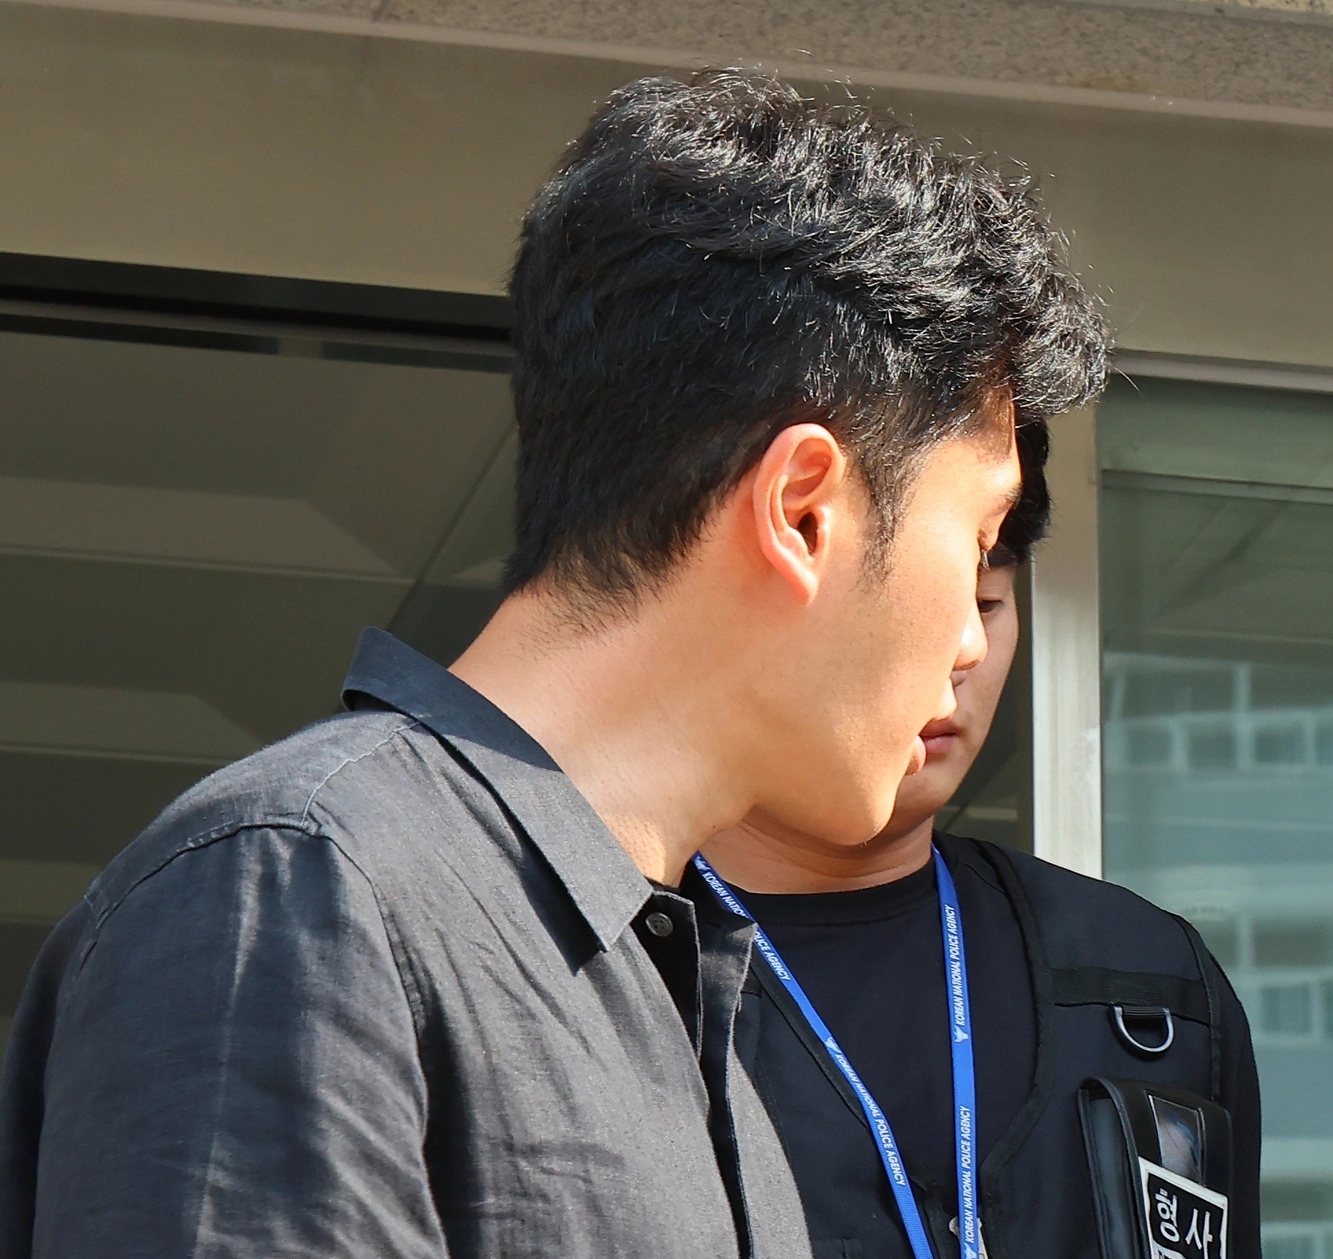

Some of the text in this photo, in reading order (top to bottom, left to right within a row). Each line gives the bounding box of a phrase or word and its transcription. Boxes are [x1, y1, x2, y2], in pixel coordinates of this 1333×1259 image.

[702, 871, 791, 981] KOREAN NATIO OLICE AGENCY
[944, 904, 965, 1026] KOREAN NATIONAL POLICE AGENCY
[834, 1053, 906, 1186] KOREAN NATIONAL POLICE AGENCY
[959, 1105, 975, 1243] KOREAN NATIONAL POLICE AGENCY
